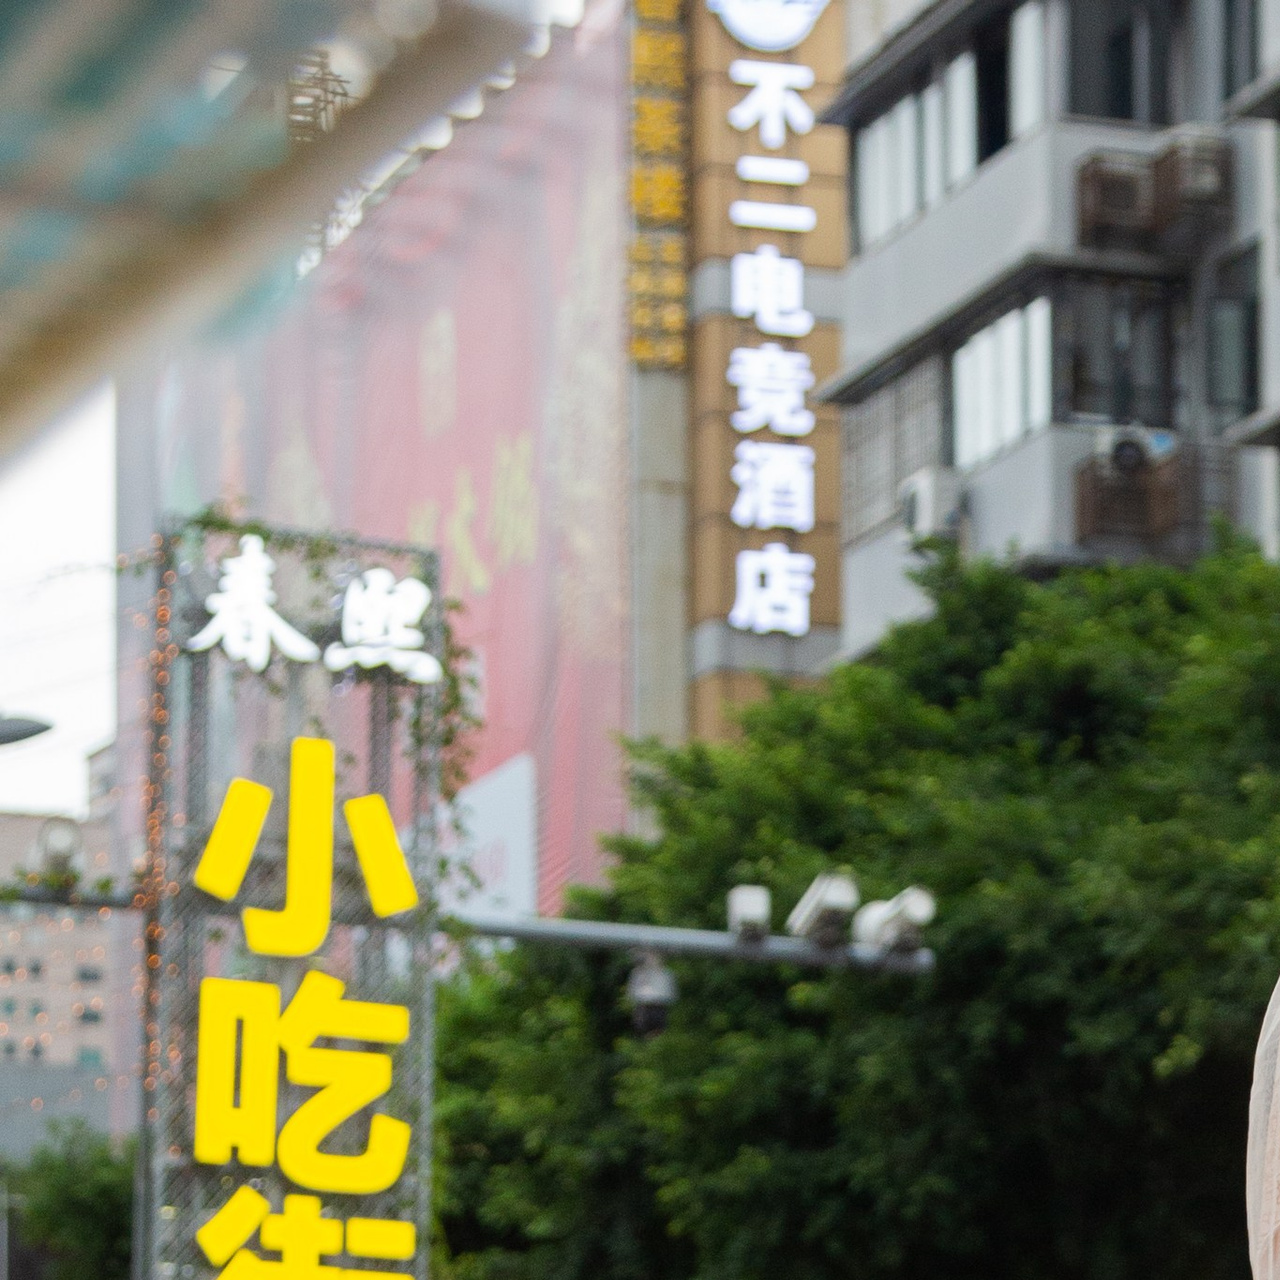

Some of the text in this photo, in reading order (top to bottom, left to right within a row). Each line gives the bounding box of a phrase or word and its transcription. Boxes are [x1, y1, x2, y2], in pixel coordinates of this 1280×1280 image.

[728, 59, 817, 637] 不二电竞酒店
[189, 534, 442, 684] 春熙
